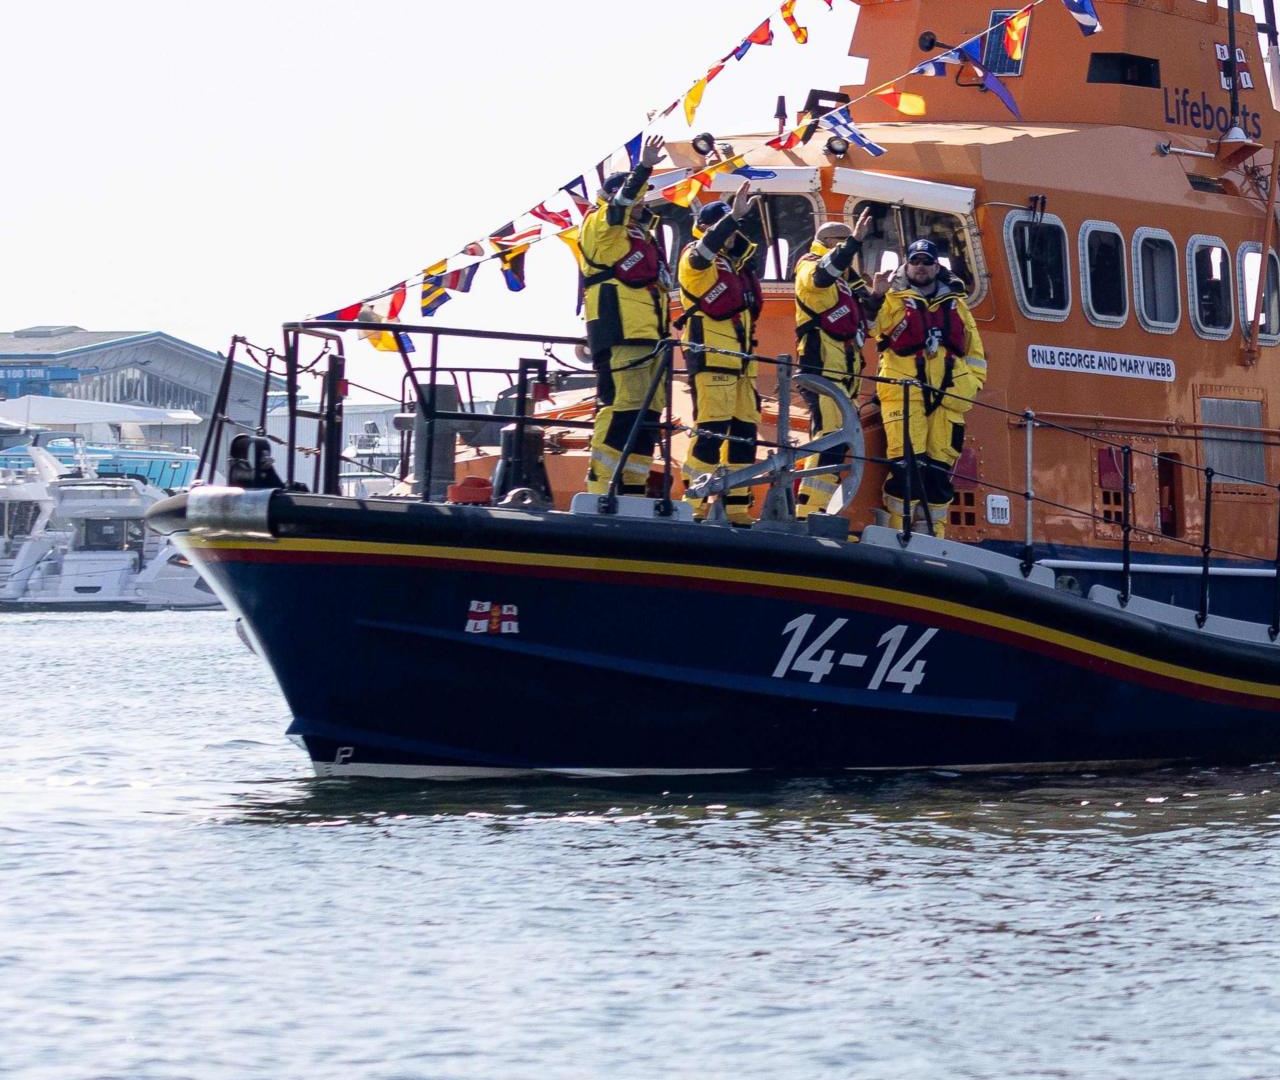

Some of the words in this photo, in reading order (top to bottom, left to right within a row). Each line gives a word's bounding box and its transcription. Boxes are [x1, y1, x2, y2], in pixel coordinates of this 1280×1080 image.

[1163, 87, 1262, 139] Lifebots
[625, 251, 642, 270] RNLI
[707, 283, 725, 302] RNLI
[830, 305, 849, 320] RNLI
[1031, 348, 1056, 366] RNLB
[1058, 351, 1096, 370] GEORGE
[1097, 354, 1118, 372] AND
[1120, 357, 1145, 375] MARY
[1147, 360, 1172, 378] WEBB
[7, 369, 24, 379] 100
[772, 613, 940, 694] 14-14
